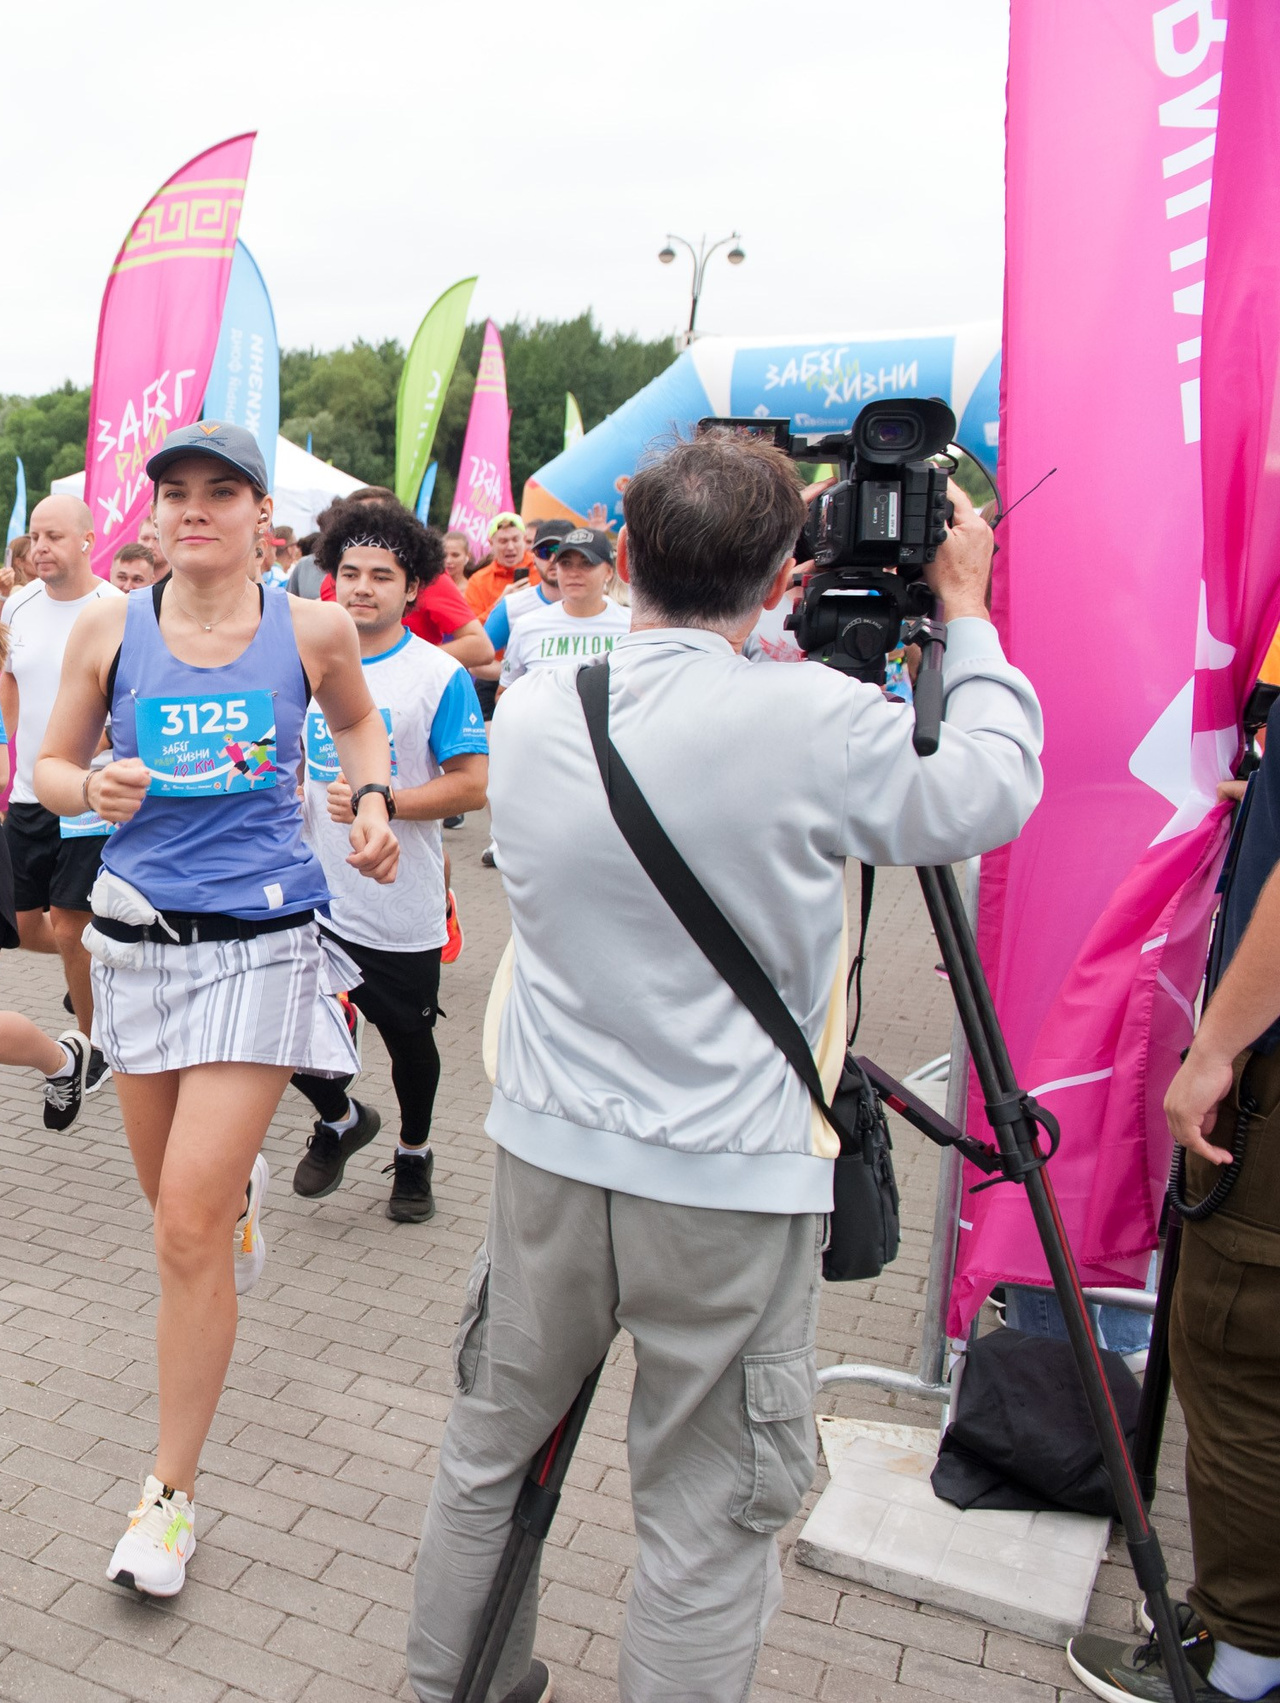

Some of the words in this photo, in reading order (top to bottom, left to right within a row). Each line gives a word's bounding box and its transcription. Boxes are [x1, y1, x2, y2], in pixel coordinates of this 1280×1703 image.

[764, 346, 850, 391] ЗАБЕГ
[823, 359, 918, 408] ЖИЗНИ
[97, 369, 196, 462] ЗАБЕГ
[541, 635, 621, 658] IZMYLON
[160, 699, 249, 736] 3125
[162, 740, 190, 756] ЗАБЕГ
[177, 747, 210, 764] ЖИЗНИ
[173, 763, 189, 778] 10
